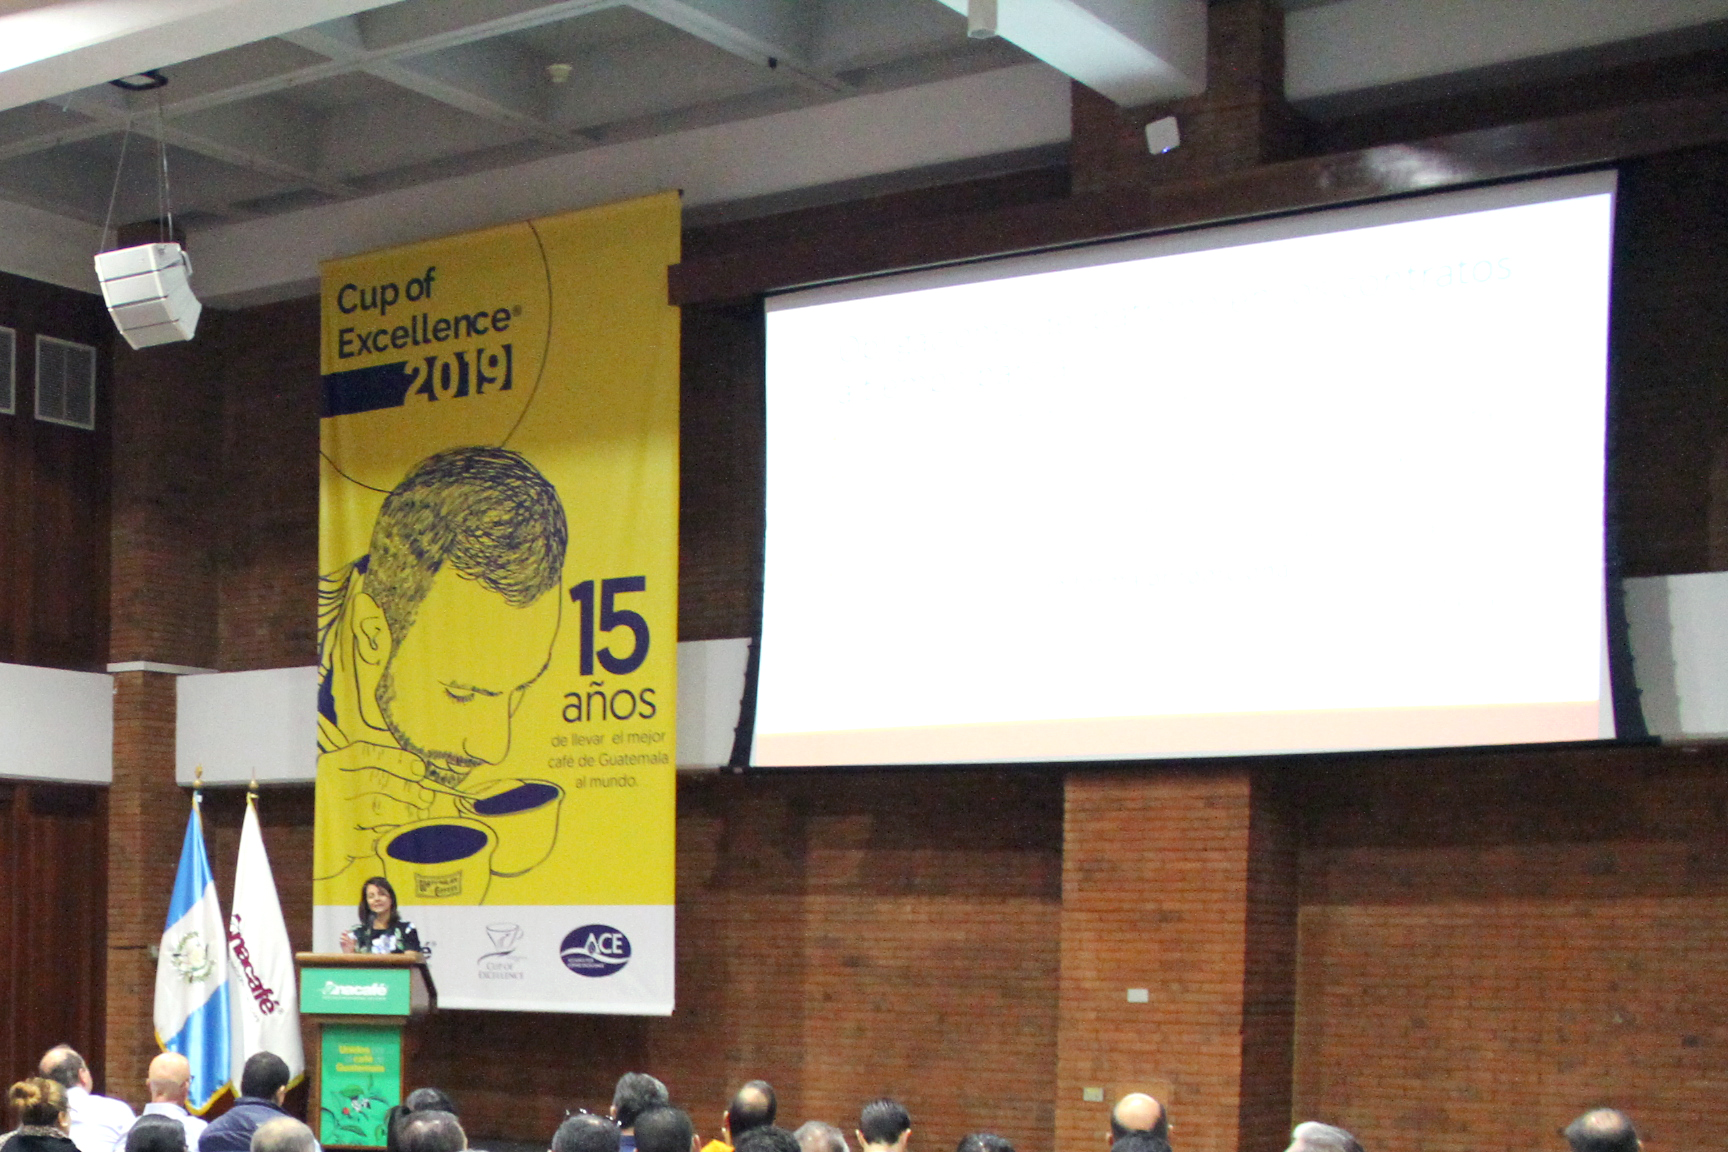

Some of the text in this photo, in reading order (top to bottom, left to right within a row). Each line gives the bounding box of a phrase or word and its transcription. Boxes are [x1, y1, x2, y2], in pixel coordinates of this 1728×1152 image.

[337, 266, 436, 315] Cup of
[338, 307, 511, 360] Excellence
[403, 344, 512, 401] 2019
[569, 575, 650, 676] 15
[562, 680, 656, 723] años
[551, 730, 665, 748] de llevar el mejor
[578, 753, 594, 767] de
[599, 751, 669, 766] Guatemala
[576, 775, 586, 789] al
[584, 932, 623, 954] ACE
